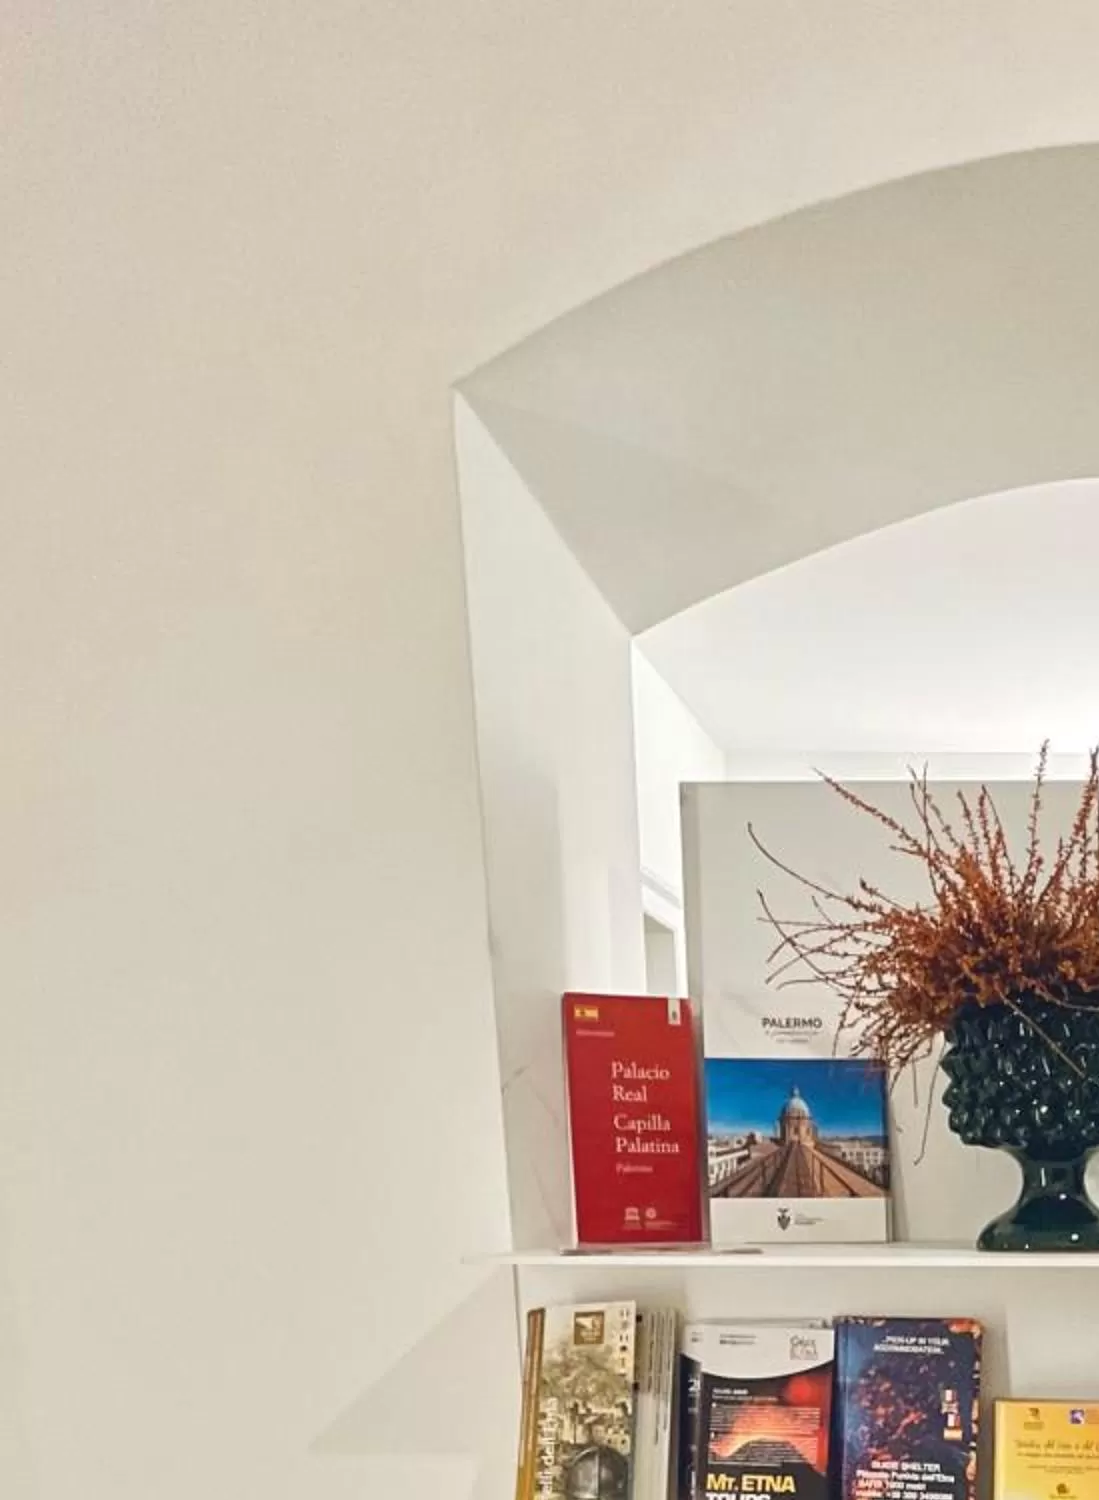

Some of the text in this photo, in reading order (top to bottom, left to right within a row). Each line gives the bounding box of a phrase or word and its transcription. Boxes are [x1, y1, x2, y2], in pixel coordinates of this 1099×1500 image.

[761, 1017, 823, 1029] PALERMO
[612, 1060, 670, 1080] Palacio
[613, 1084, 647, 1101] Real
[614, 1114, 671, 1134] Capilla
[616, 1136, 680, 1153] Palatina
[741, 1473, 796, 1493] ETNA
